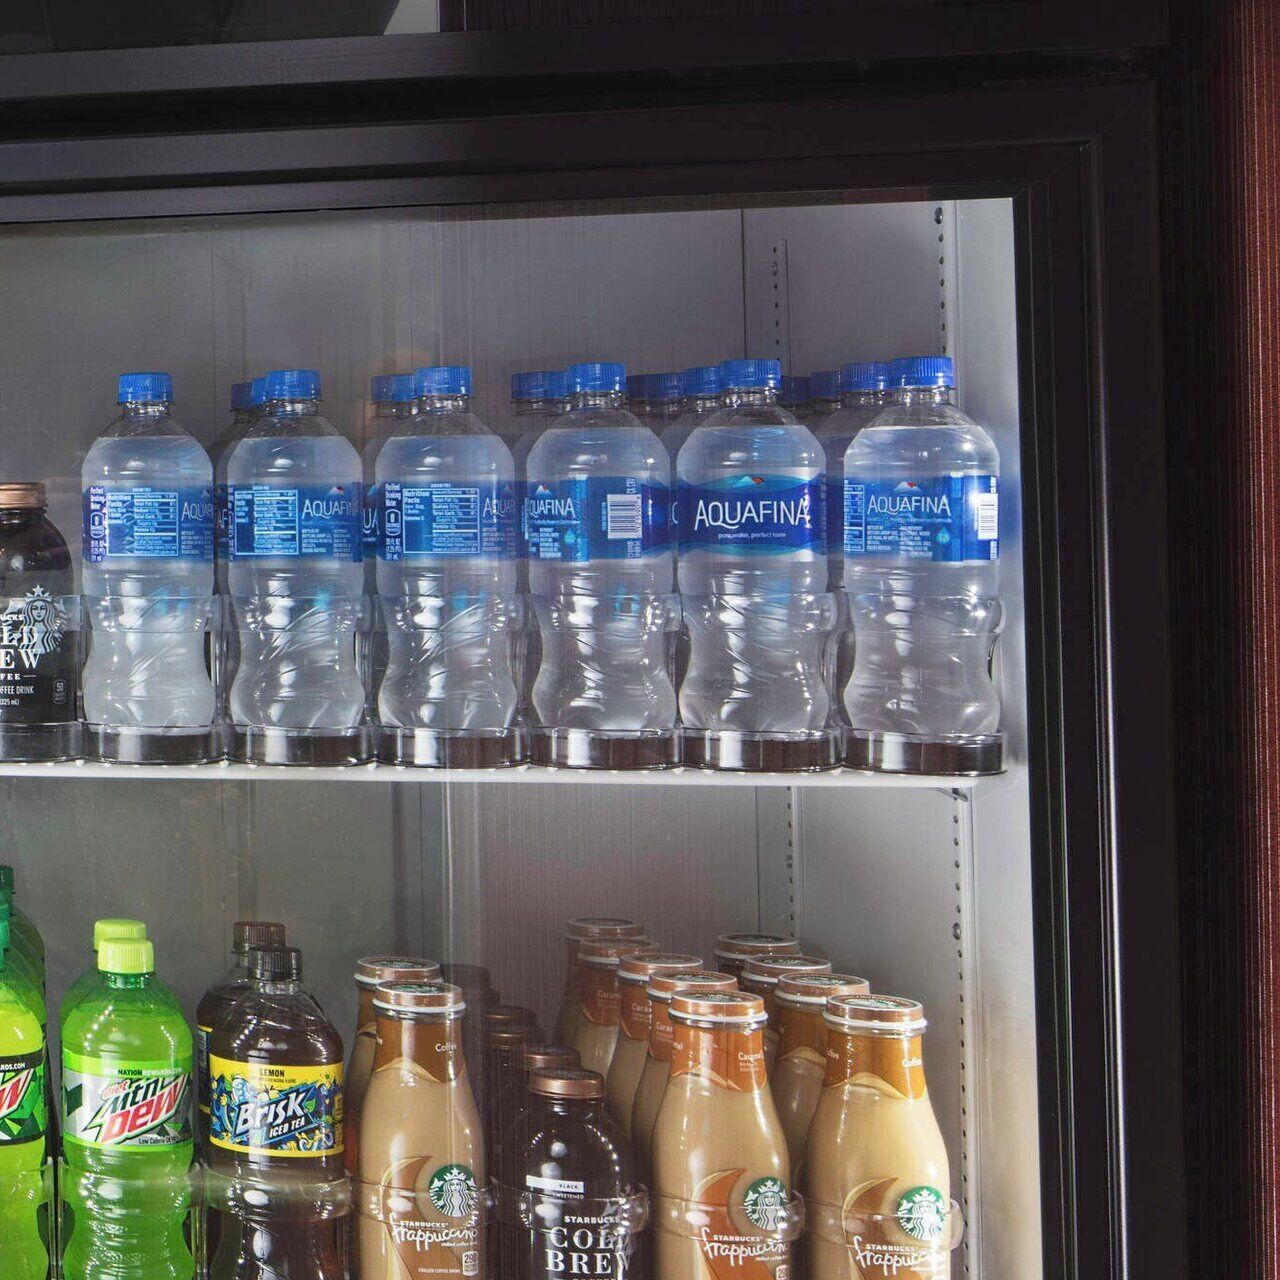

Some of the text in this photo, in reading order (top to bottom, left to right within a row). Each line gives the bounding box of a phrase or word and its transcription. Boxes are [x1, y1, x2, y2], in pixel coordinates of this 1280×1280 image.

[867, 494, 952, 516] AQUAFINA
[694, 498, 808, 531] AQUAFINA
[16, 685, 34, 694] DRINK
[259, 1068, 285, 1078] LEMON
[269, 1116, 306, 1138] ICED TEA
[712, 1234, 763, 1242] STARBUCKS
[865, 1243, 919, 1251] STARBUCKS
